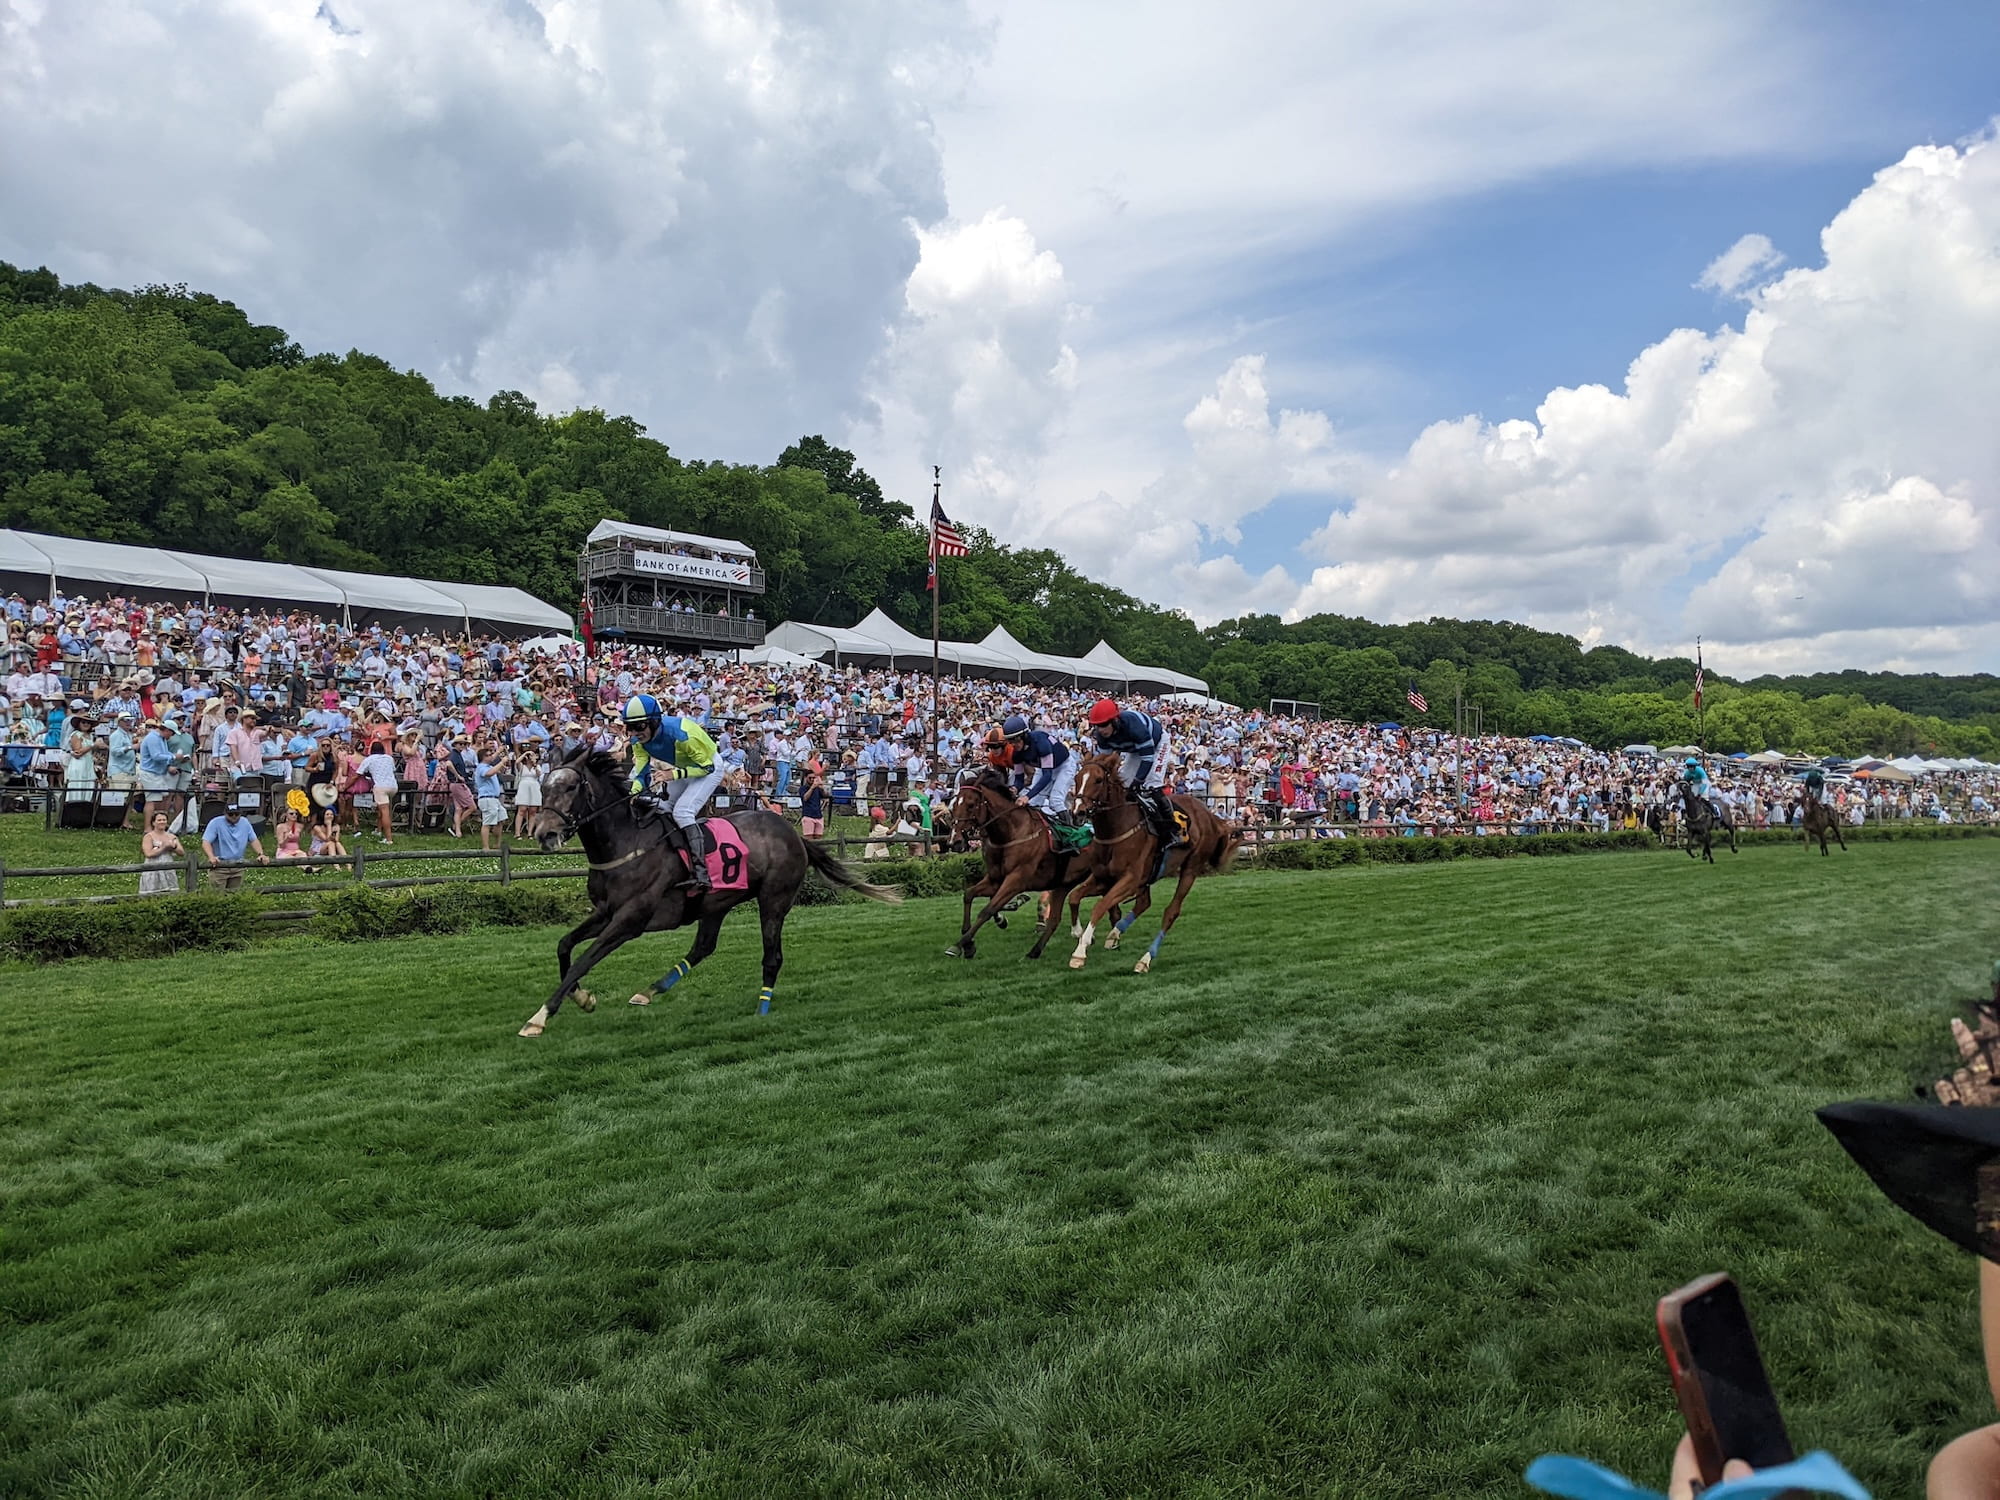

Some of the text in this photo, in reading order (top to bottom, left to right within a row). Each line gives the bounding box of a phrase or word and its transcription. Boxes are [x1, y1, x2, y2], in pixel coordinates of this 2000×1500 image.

[635, 559, 727, 578] BANK OF AMERICA
[719, 843, 742, 884] 8
